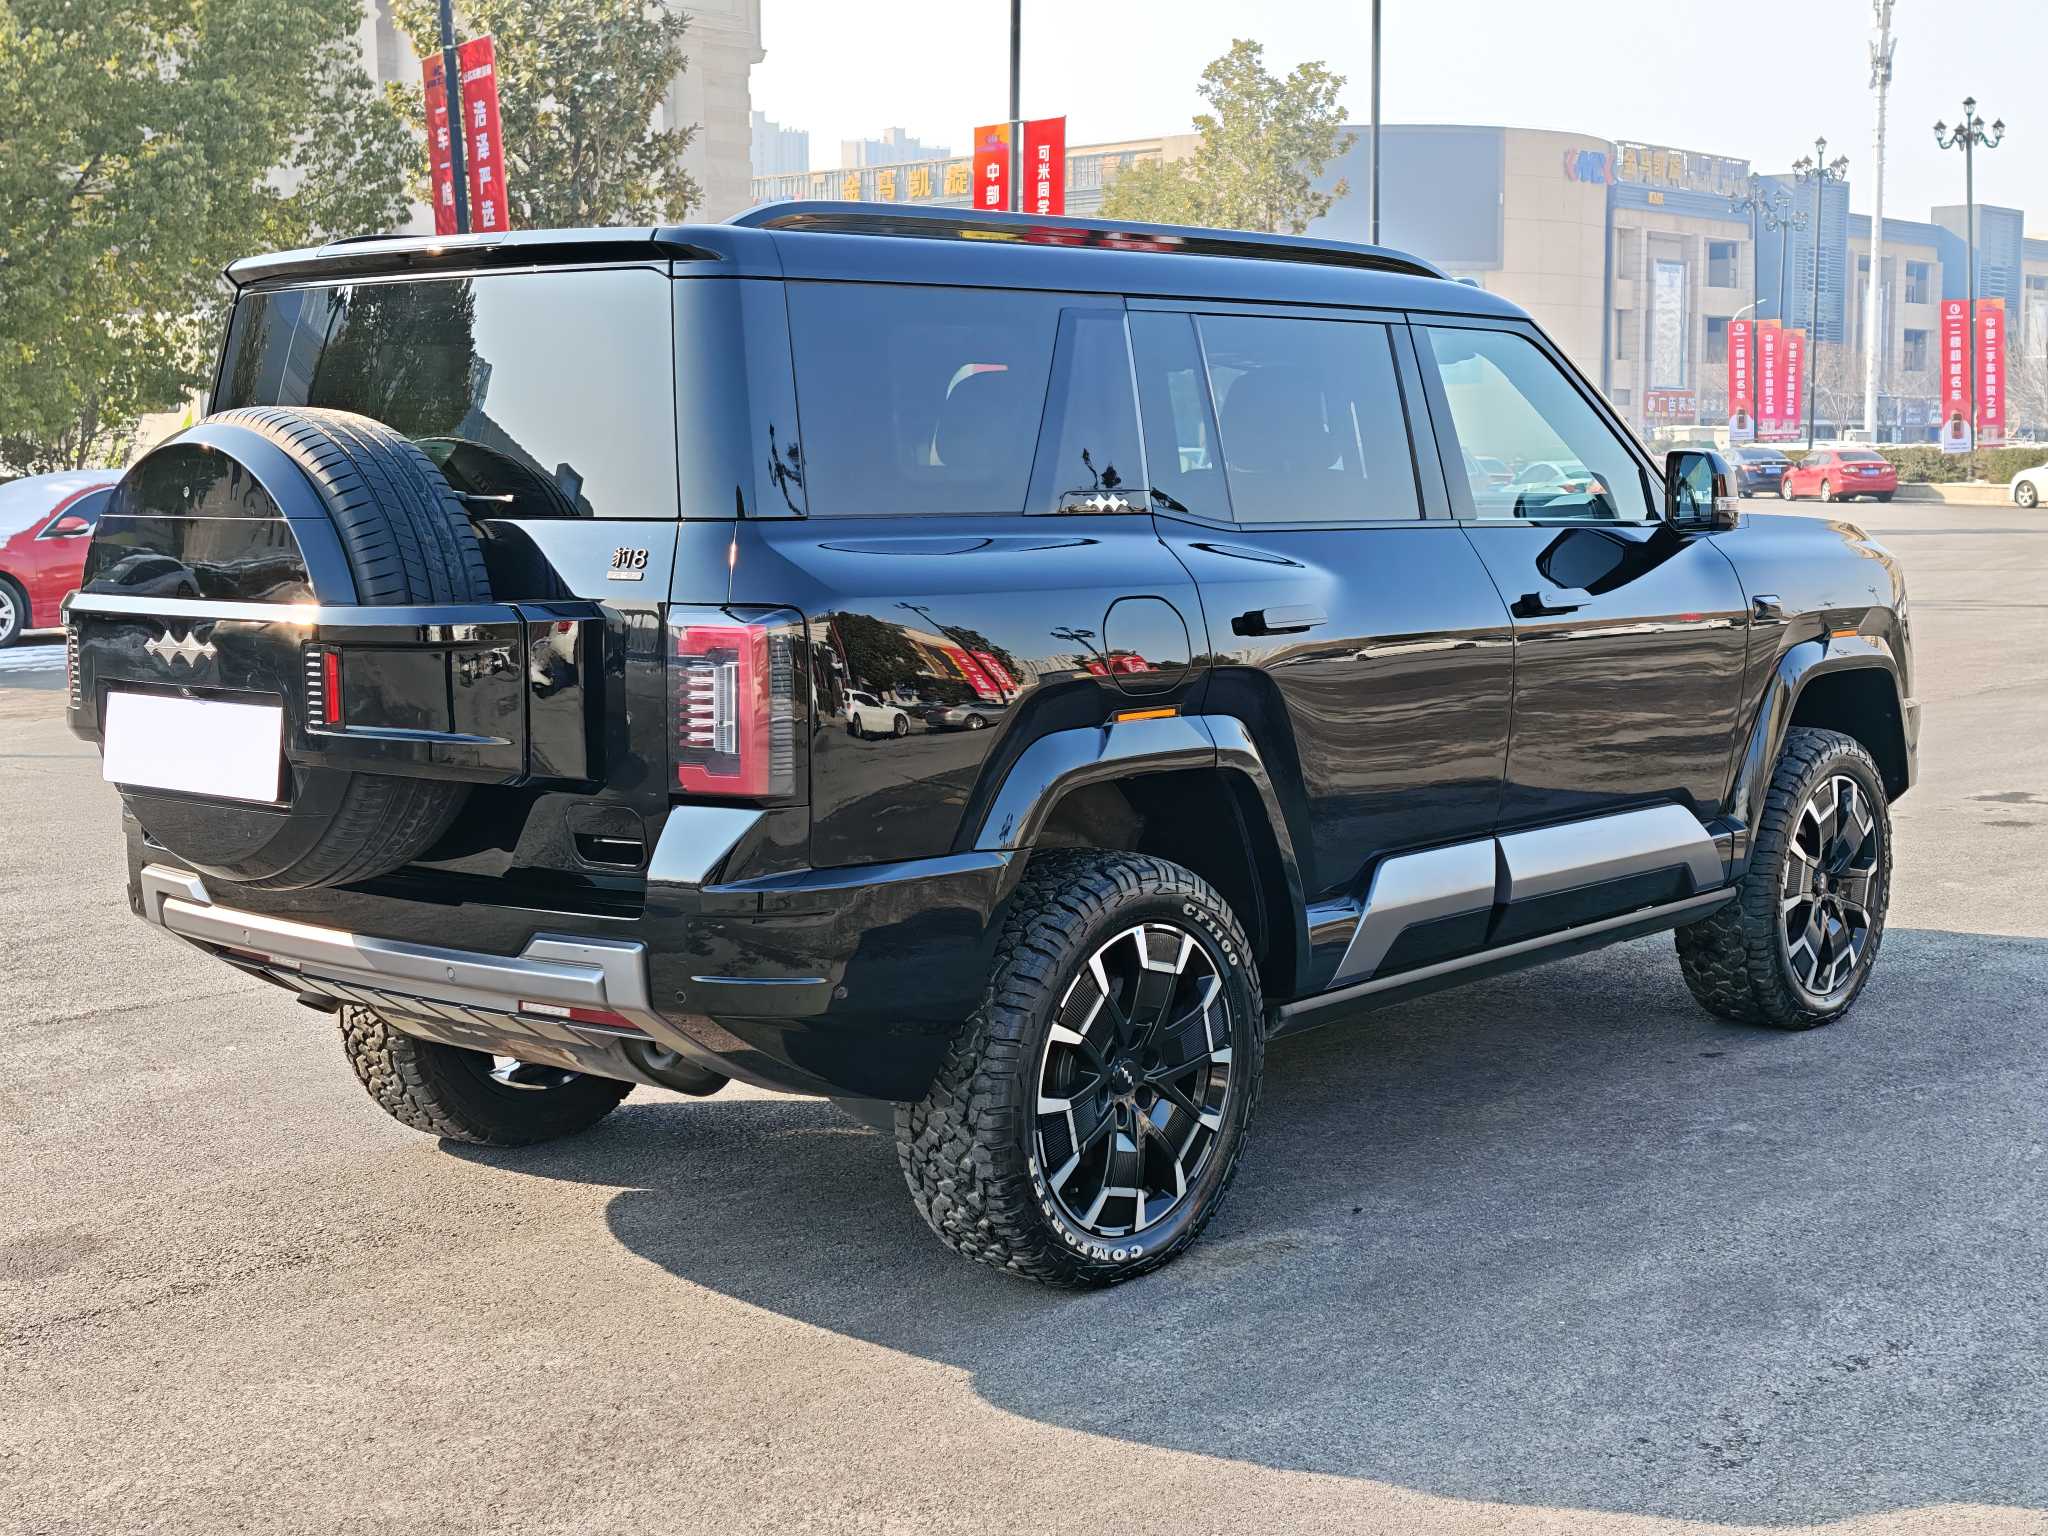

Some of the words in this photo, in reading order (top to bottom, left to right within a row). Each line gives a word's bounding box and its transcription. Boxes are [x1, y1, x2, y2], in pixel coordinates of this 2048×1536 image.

[842, 163, 968, 200] 金马凯旋
[986, 162, 1000, 211] 中部
[1037, 144, 1051, 215] 可米同学
[611, 547, 648, 569] 豹8
[1182, 902, 1239, 967] CF1100
